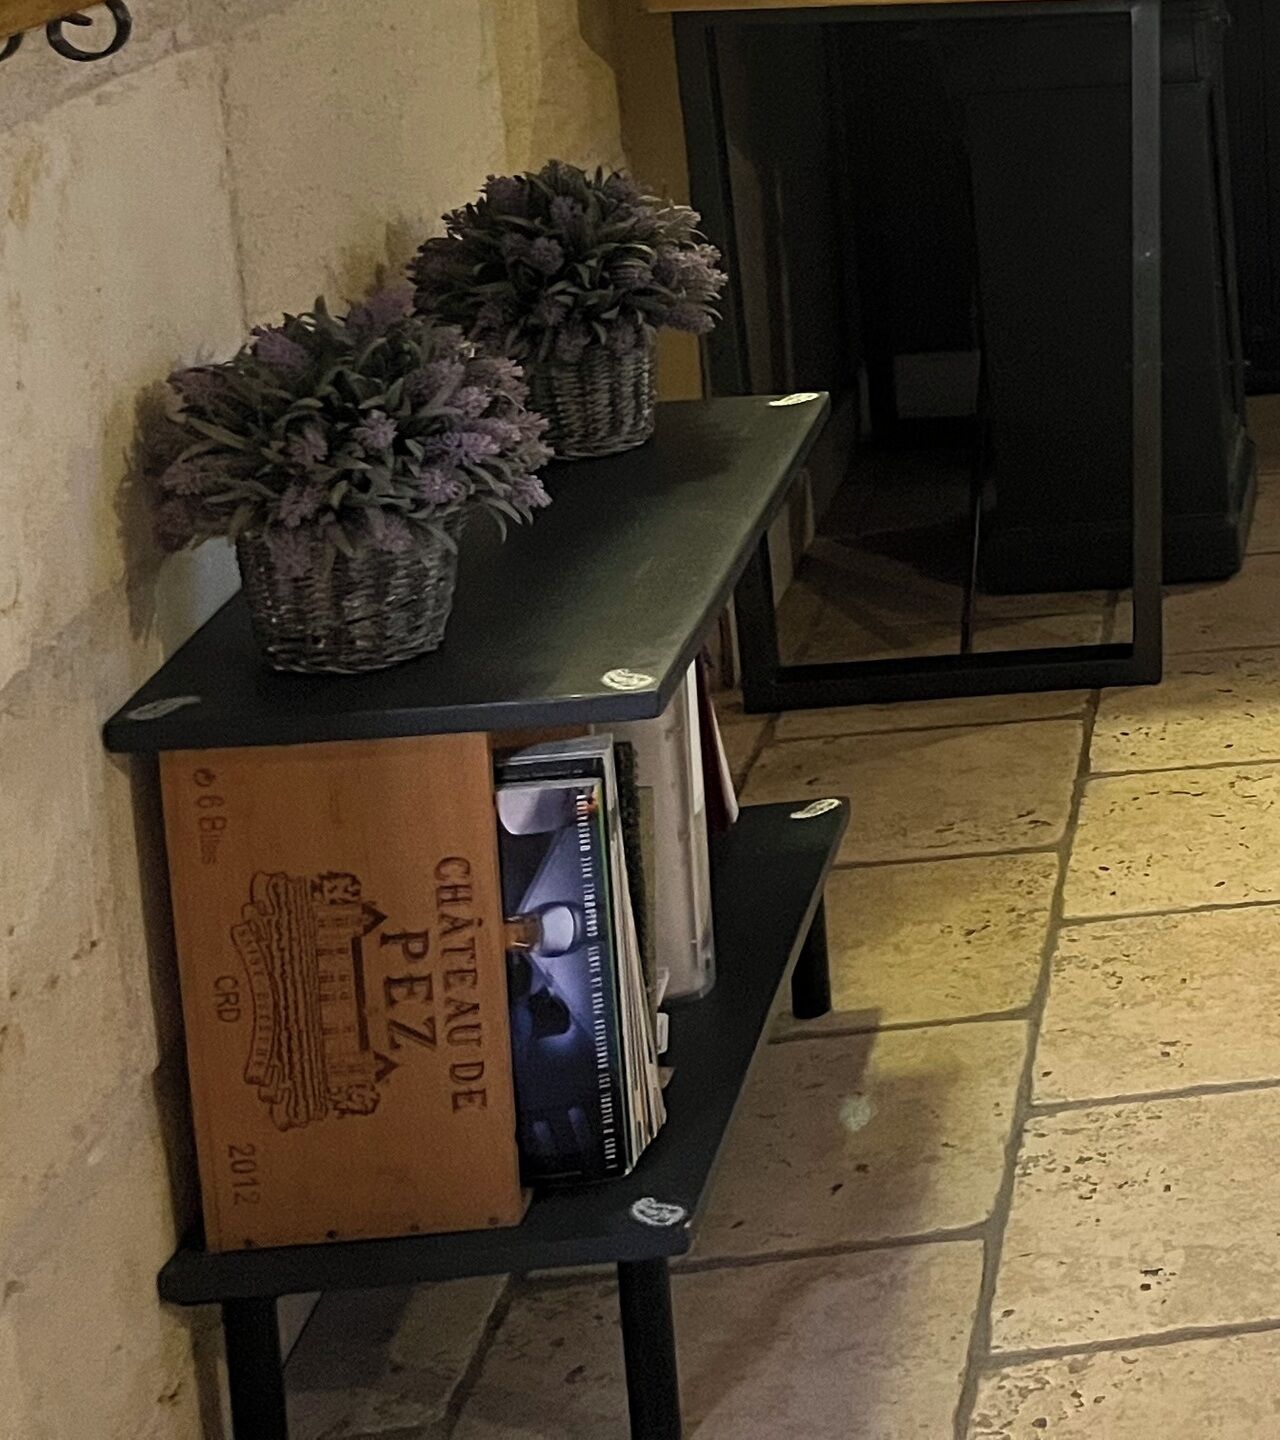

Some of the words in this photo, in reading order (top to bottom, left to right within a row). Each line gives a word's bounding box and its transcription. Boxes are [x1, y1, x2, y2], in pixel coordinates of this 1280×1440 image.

[213, 974, 242, 1023] CRD
[379, 928, 438, 1051] PEZ
[449, 1061, 488, 1113] DE
[228, 1143, 260, 1206] 2012
